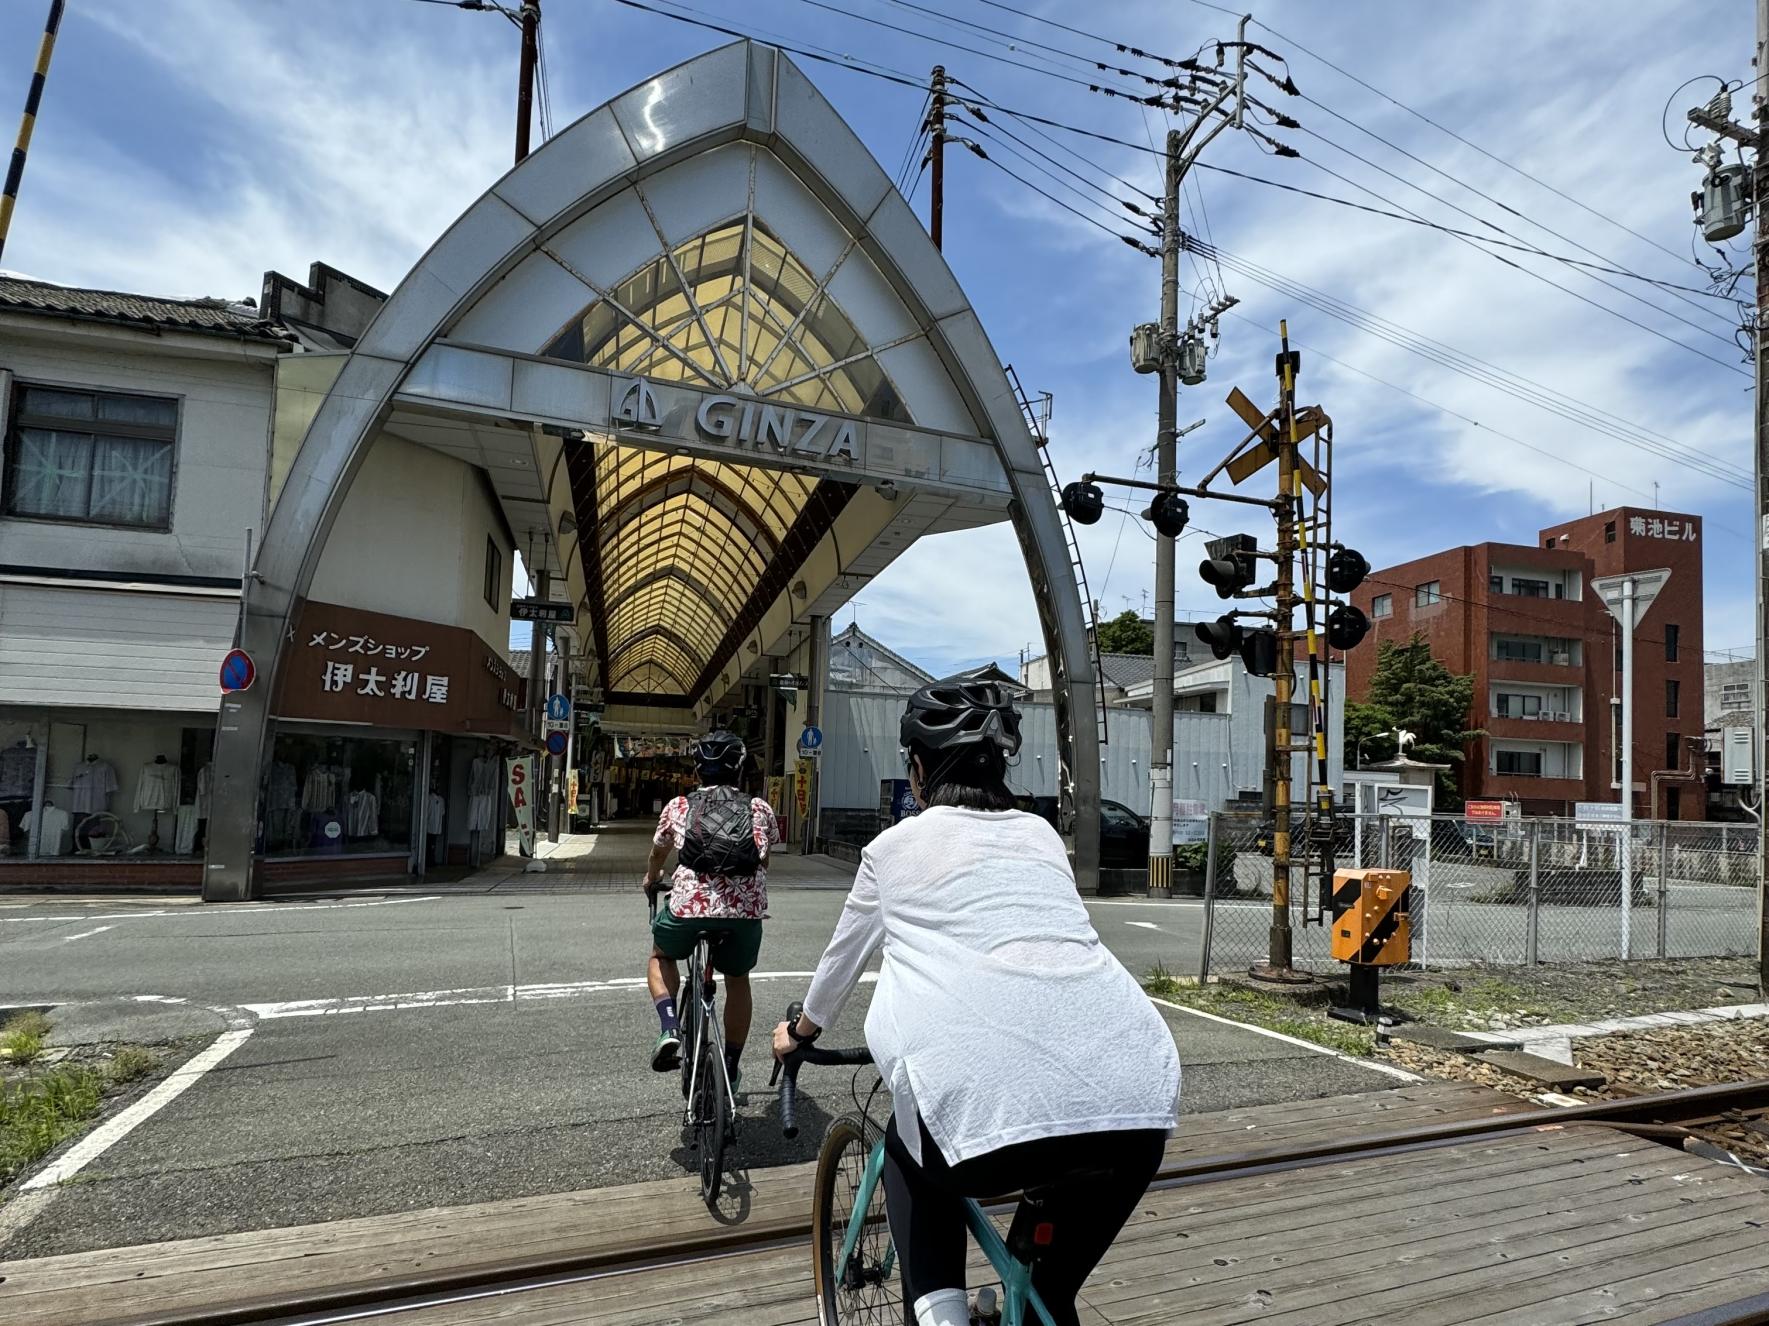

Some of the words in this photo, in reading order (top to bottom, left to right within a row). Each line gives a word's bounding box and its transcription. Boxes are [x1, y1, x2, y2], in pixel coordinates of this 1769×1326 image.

[696, 395, 859, 461] GINZA
[1629, 516, 1697, 542] 菊池ビル
[308, 631, 430, 661] メンズショップ
[321, 661, 449, 704] 伊太利屋
